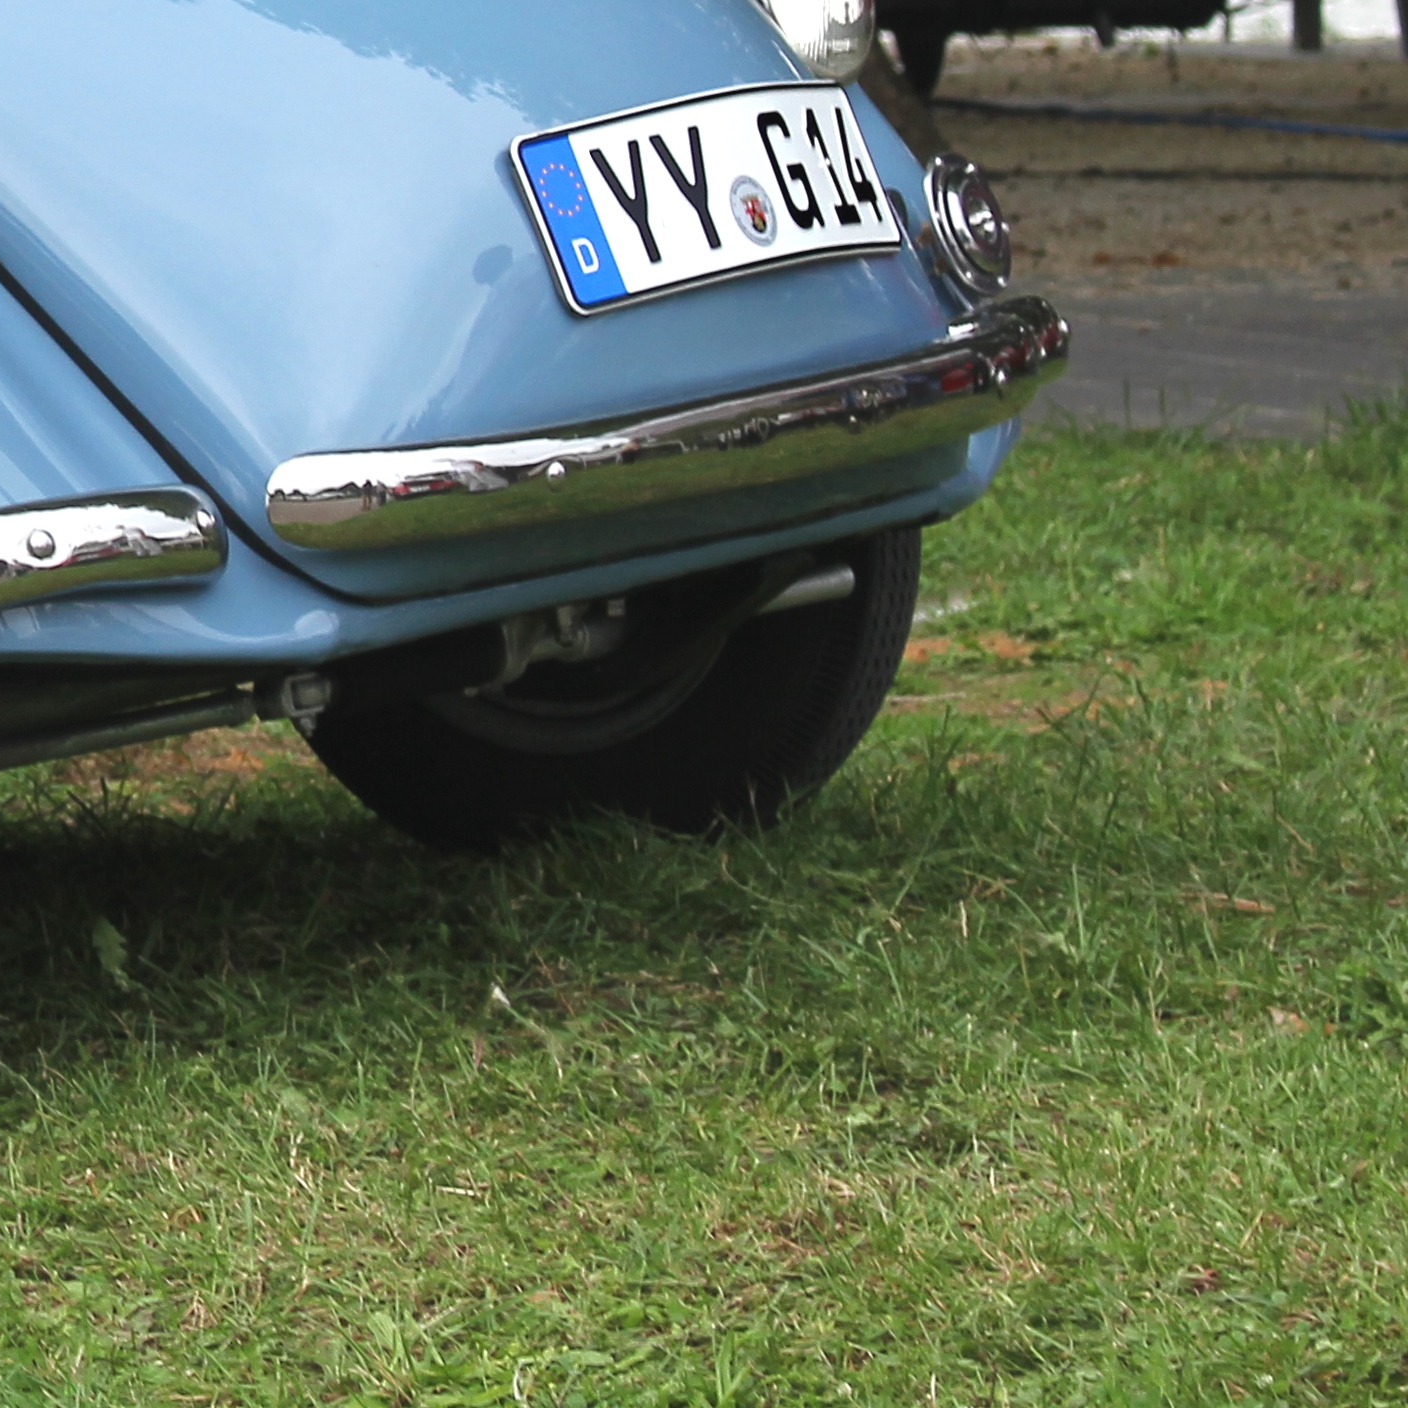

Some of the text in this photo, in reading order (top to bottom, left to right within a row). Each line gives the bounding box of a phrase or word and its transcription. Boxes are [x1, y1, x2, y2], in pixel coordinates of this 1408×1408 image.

[589, 125, 722, 264] YY
[756, 105, 885, 231] G14
[572, 237, 600, 275] D
